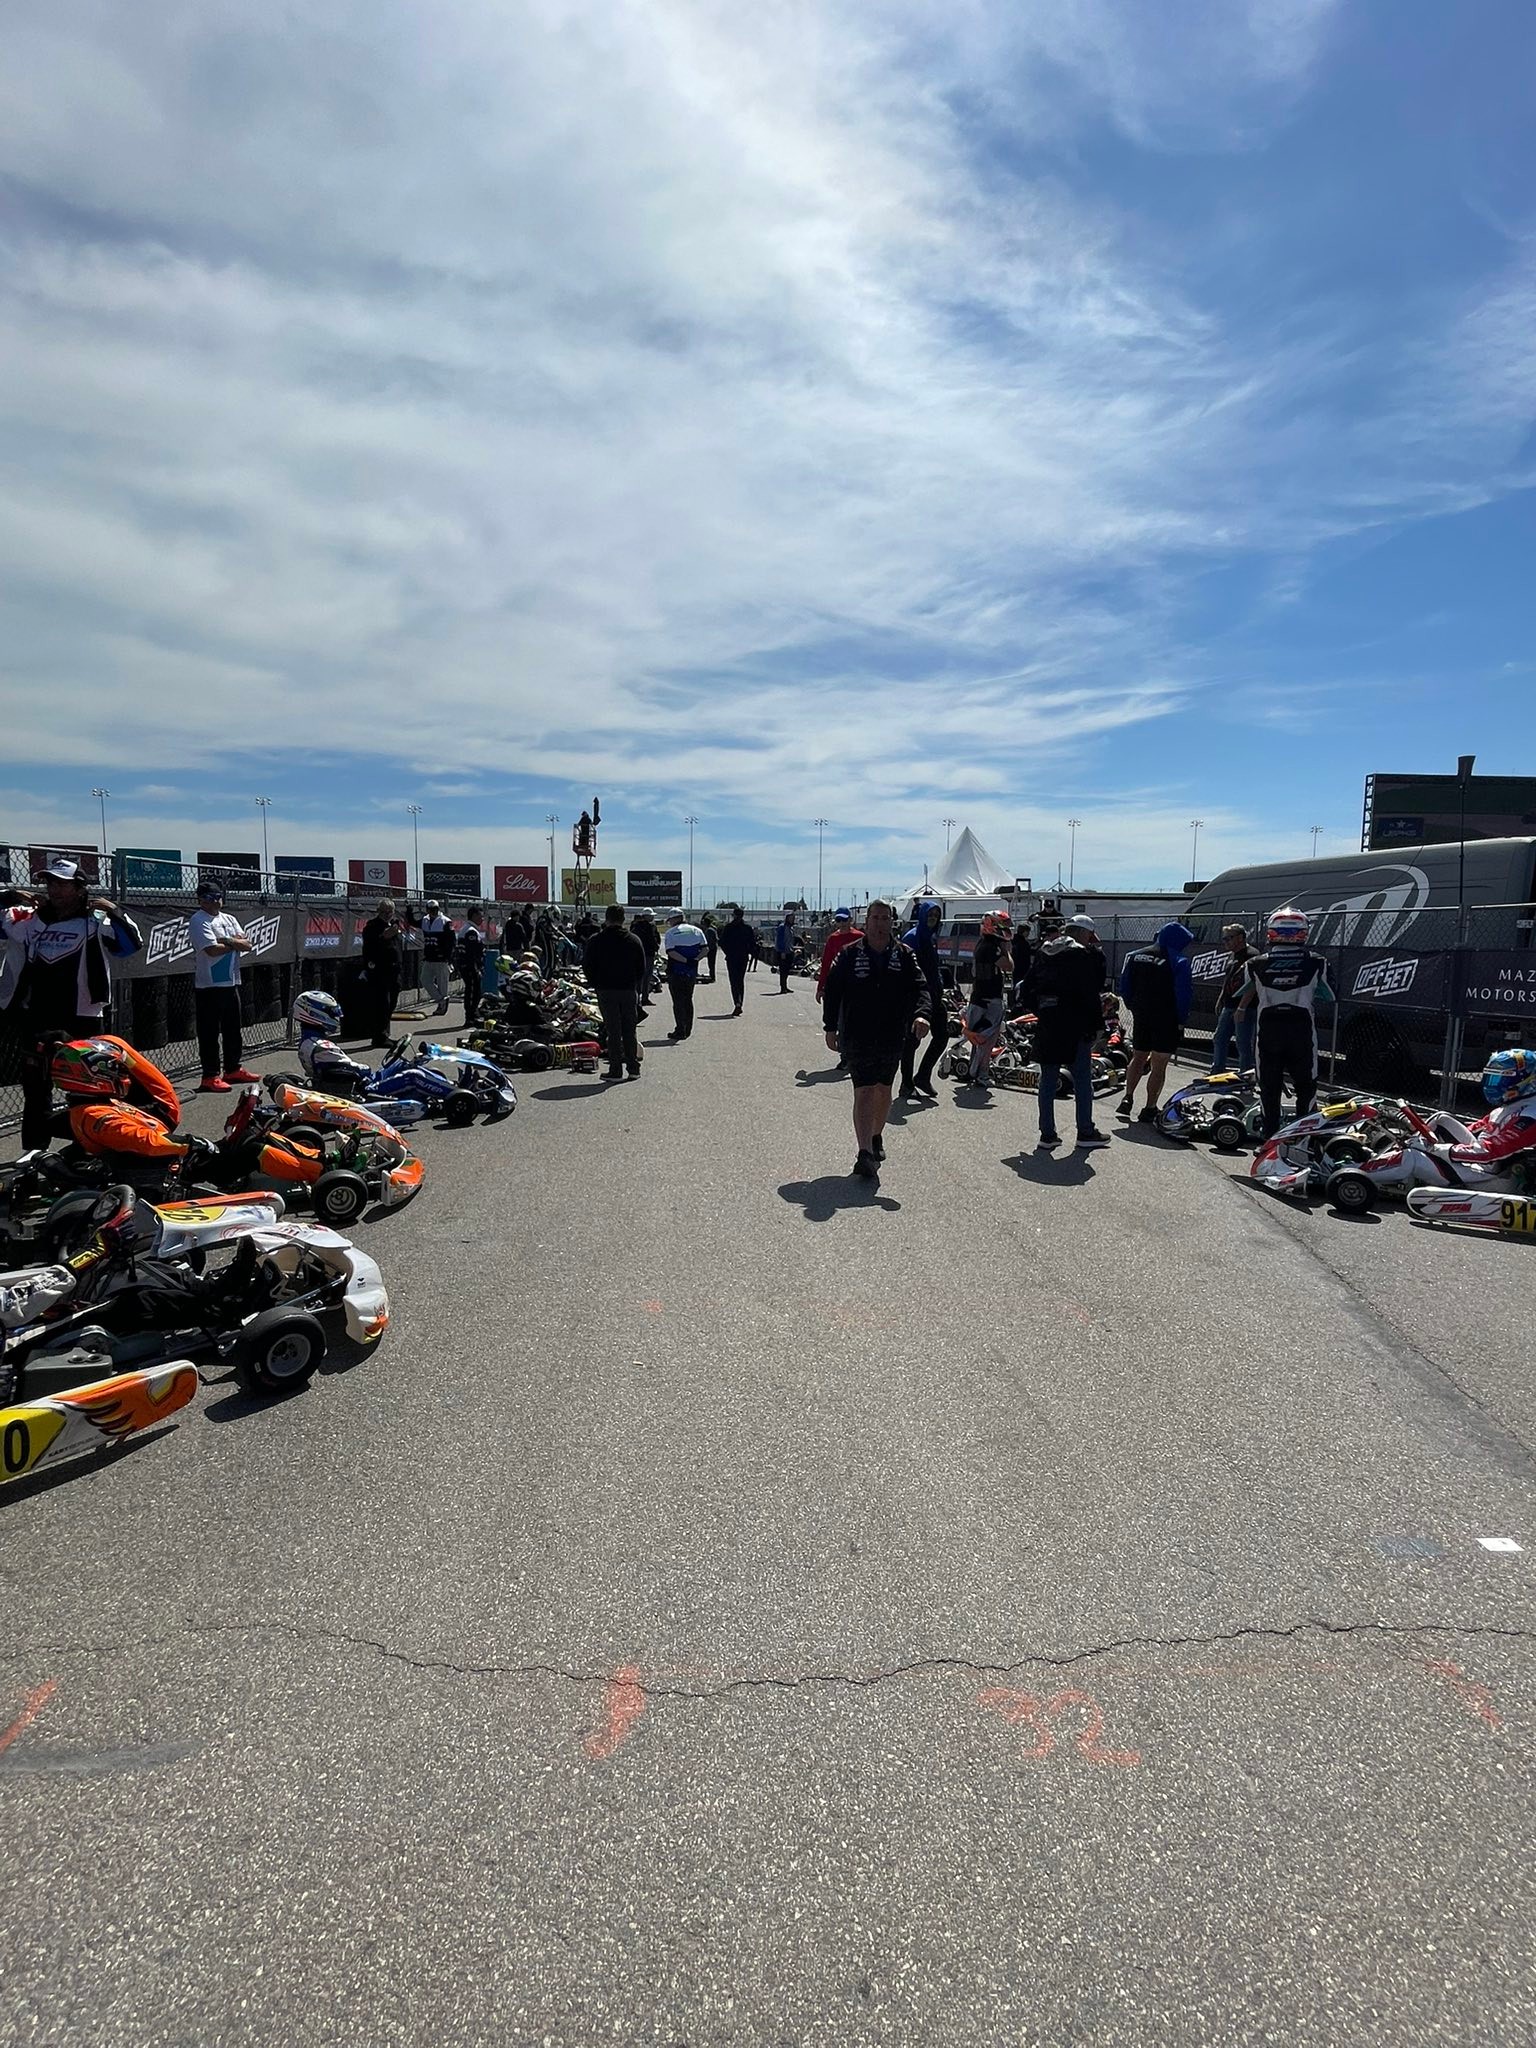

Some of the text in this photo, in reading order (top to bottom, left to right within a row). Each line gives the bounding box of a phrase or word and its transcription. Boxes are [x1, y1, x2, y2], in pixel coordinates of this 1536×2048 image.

[503, 873, 540, 894] Lilly
[151, 924, 192, 954] OFFSE
[1191, 955, 1229, 976] OFFSET
[1498, 969, 1536, 982] MAZ
[1356, 964, 1413, 991] OFFSET
[1465, 987, 1536, 1003] MOTORS
[4, 1419, 30, 1474] 0
